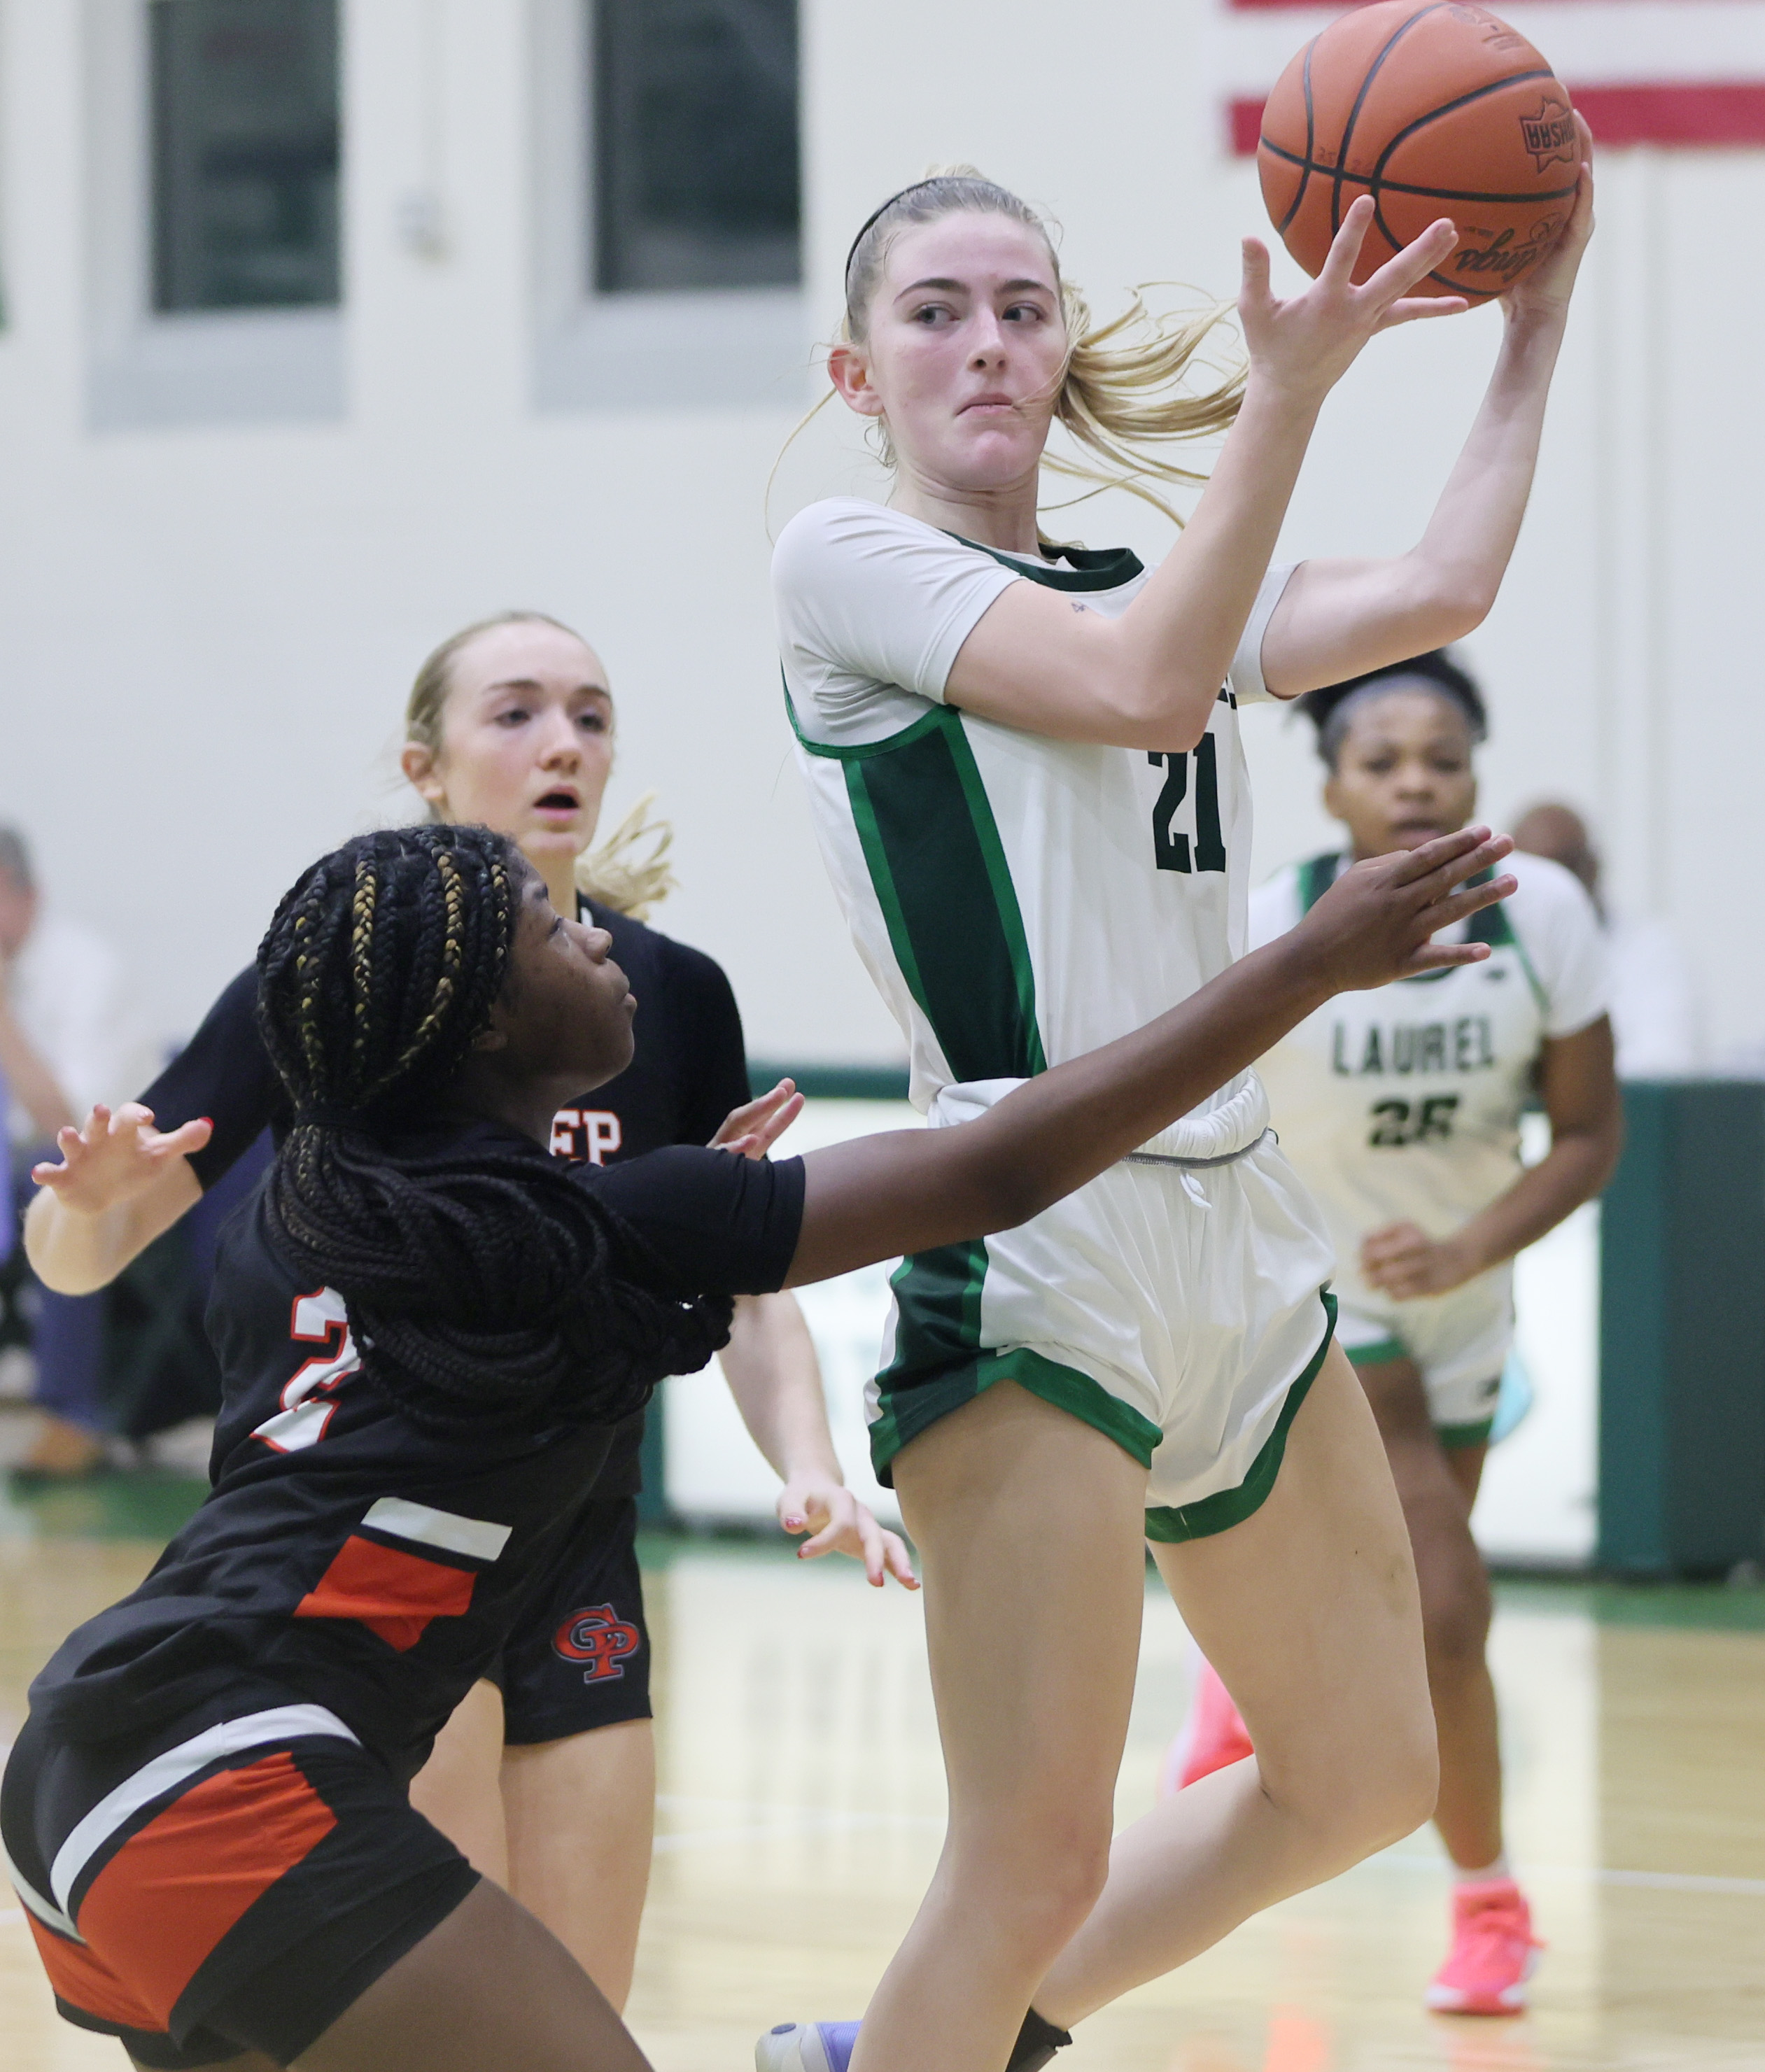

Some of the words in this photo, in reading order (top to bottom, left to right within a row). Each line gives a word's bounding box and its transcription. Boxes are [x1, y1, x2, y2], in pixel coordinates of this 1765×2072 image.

[1148, 732, 1226, 874] 21
[1332, 1015, 1496, 1076] LAUREL
[249, 1285, 374, 1453] 2
